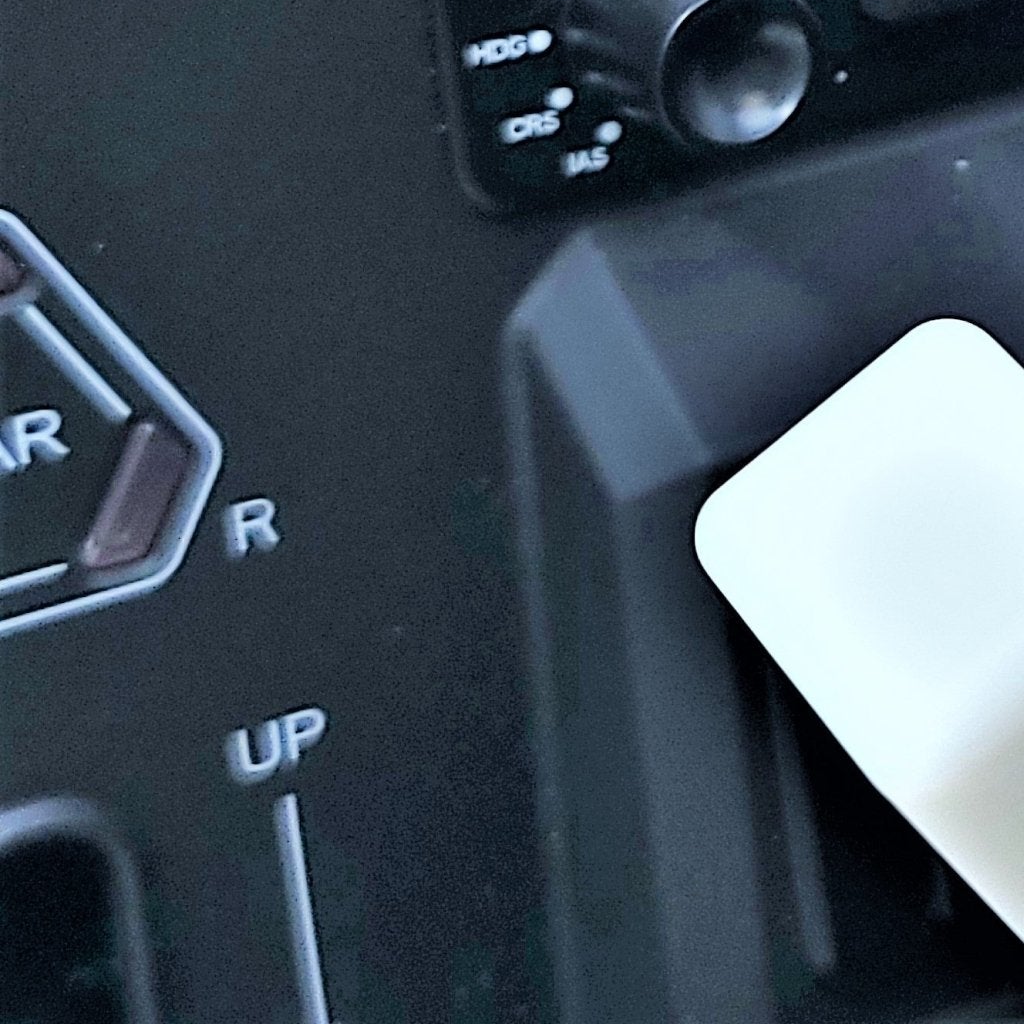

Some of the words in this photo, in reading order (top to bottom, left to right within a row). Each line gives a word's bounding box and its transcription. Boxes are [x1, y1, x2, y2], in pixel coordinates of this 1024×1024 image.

[464, 34, 527, 67] HDG
[501, 110, 560, 144] CRS
[563, 146, 609, 176] IAS
[0, 408, 70, 472] R
[224, 497, 280, 559] R
[228, 706, 327, 782] UP
